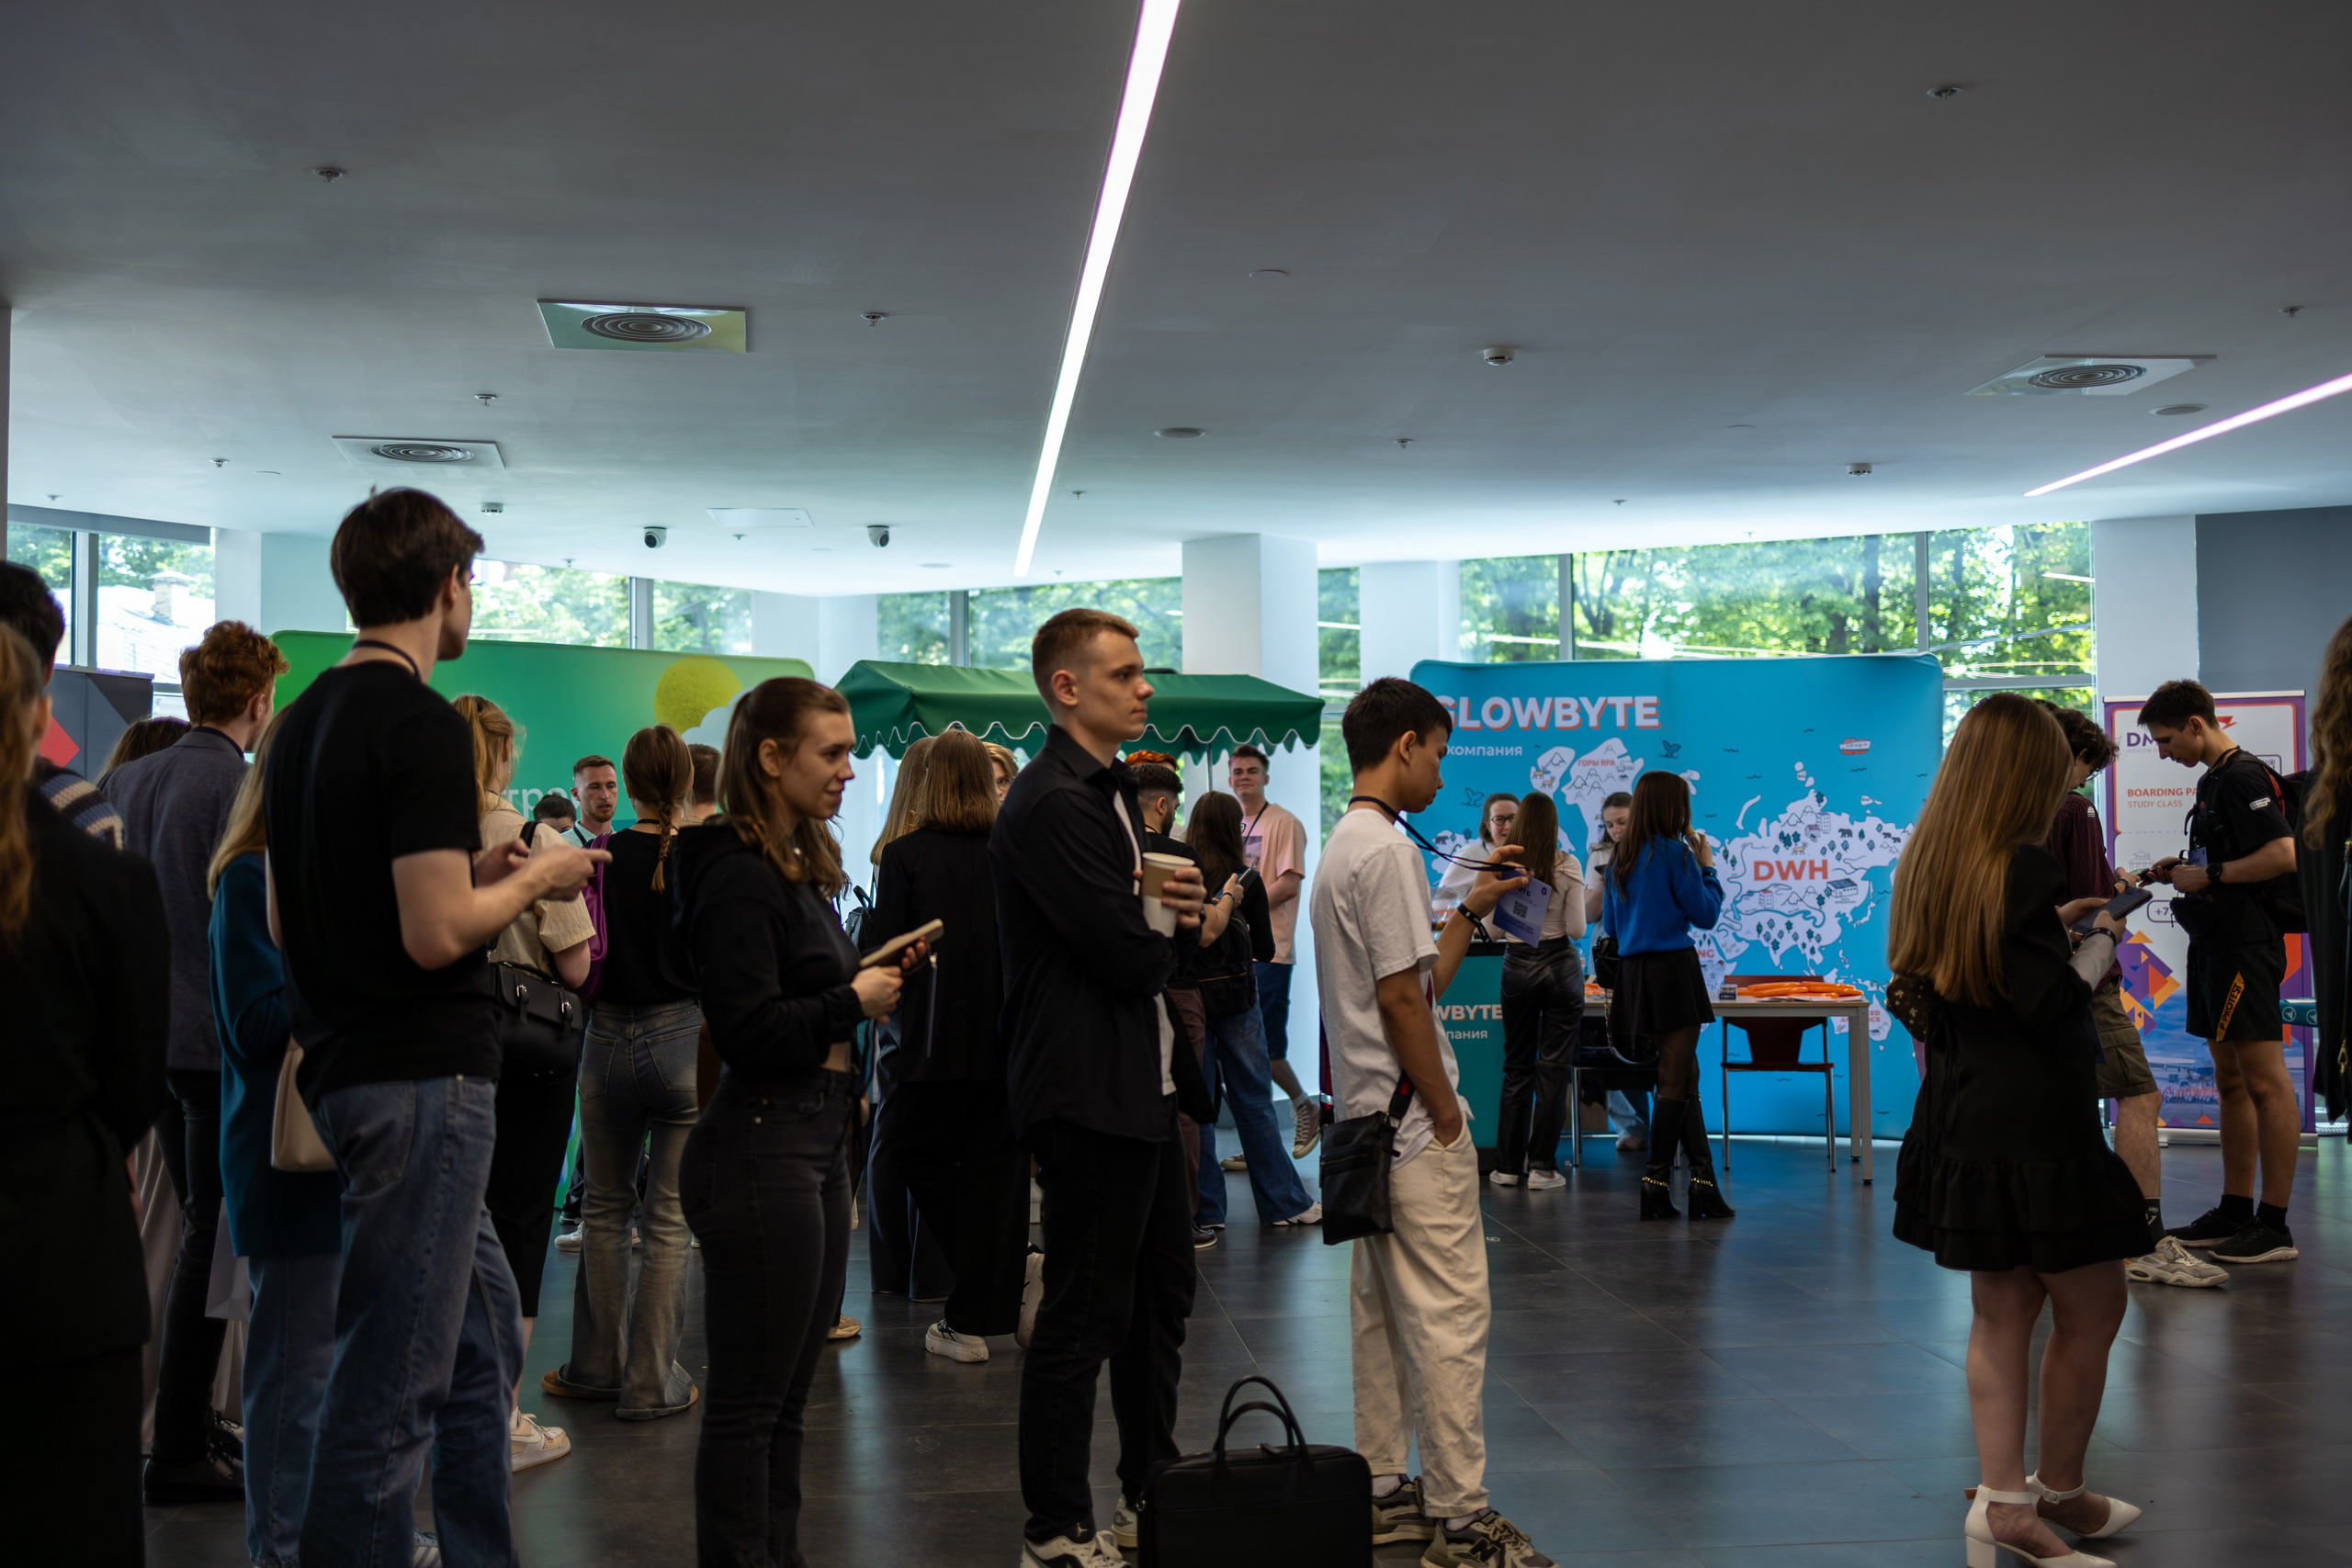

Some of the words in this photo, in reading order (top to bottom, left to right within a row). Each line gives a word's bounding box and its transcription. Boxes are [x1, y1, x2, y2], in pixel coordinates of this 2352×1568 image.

[1447, 744, 1522, 756] компания
[1577, 759, 1599, 767] ГОРЫ
[1600, 759, 1616, 767] RPA
[2127, 788, 2183, 797] BOARDING
[2156, 800, 2183, 808] CLASS
[1753, 859, 1828, 881] DWH
[2222, 983, 2242, 1021] PROTEST
